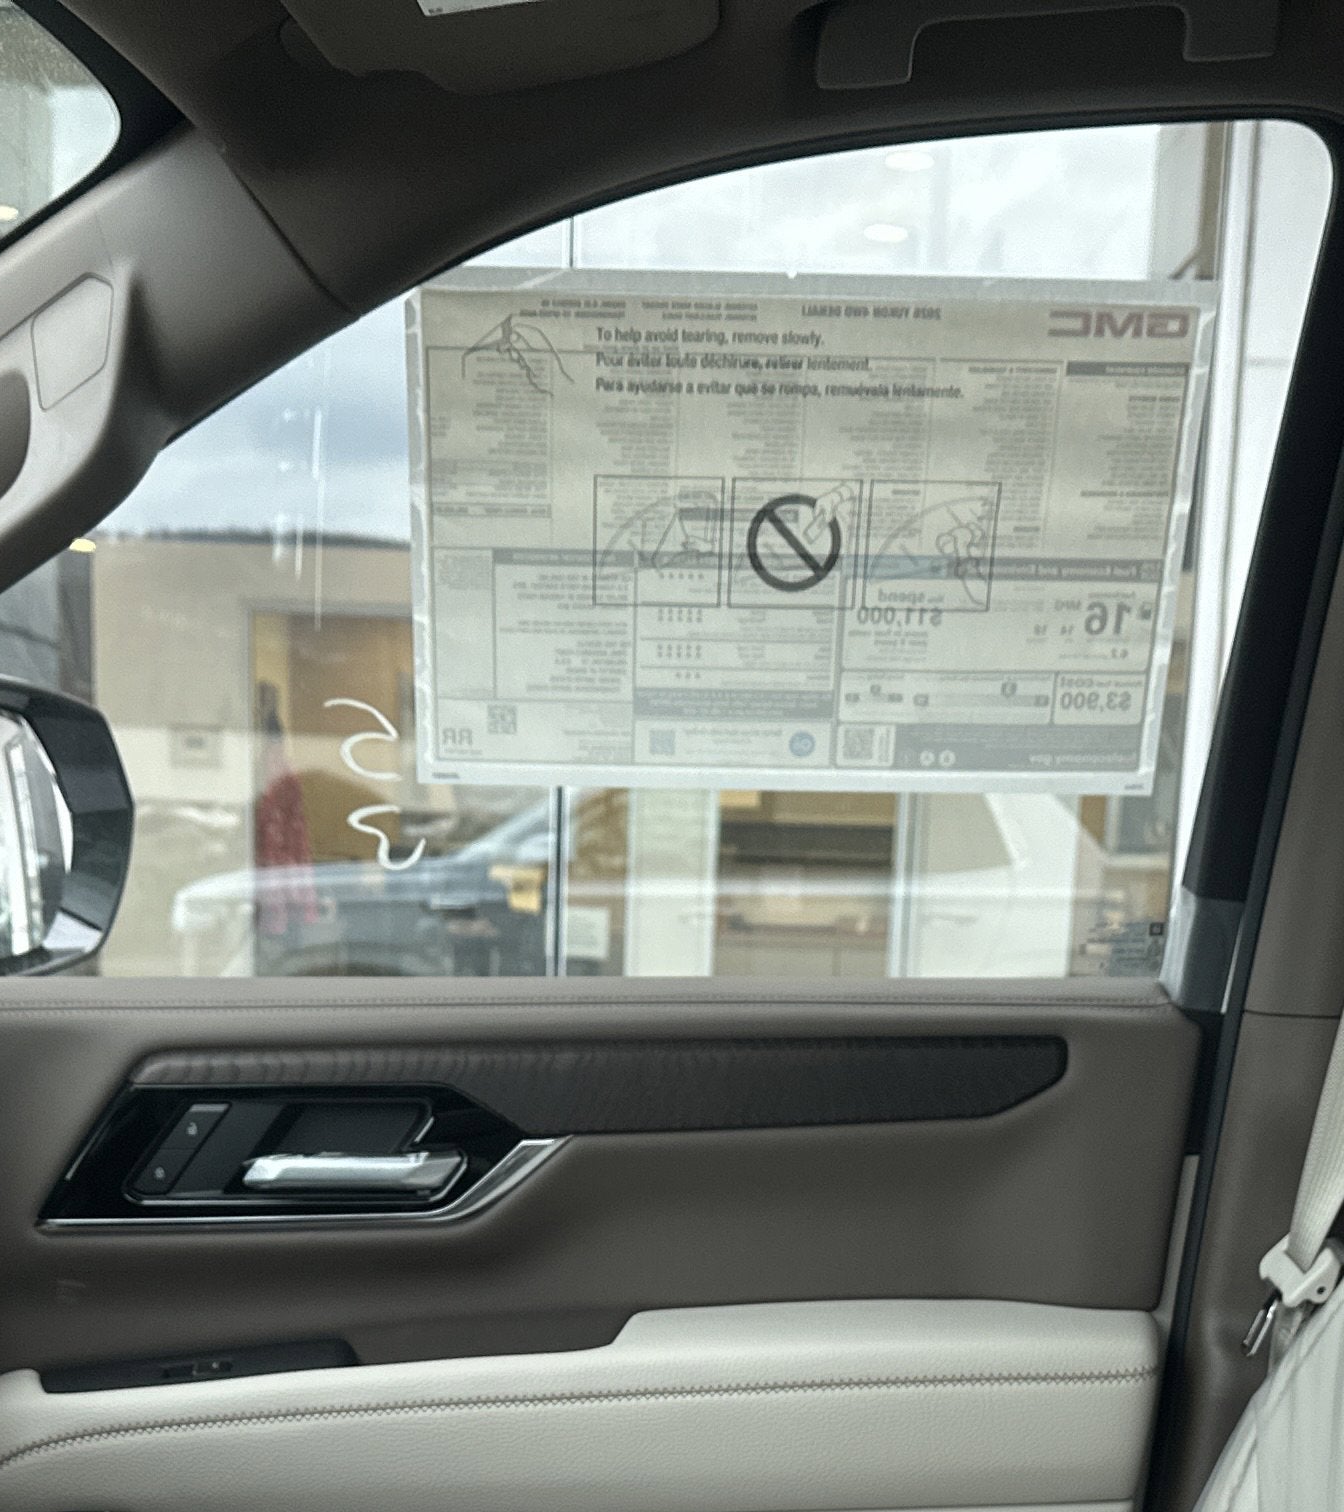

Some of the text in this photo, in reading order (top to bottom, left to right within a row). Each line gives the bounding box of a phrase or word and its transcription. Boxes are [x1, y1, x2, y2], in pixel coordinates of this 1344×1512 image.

[596, 326, 825, 348] To help avoid tearing, remove slowly.
[595, 351, 624, 369] Pour
[665, 353, 698, 369] toute
[806, 356, 873, 372] lentement.
[595, 377, 624, 393] Para
[627, 378, 684, 396] ayudarse
[685, 383, 694, 395] a
[696, 380, 732, 396] evitar
[734, 383, 758, 398] que
[761, 384, 776, 397] se
[778, 383, 822, 399] rompa,
[892, 382, 965, 400] lentamente.
